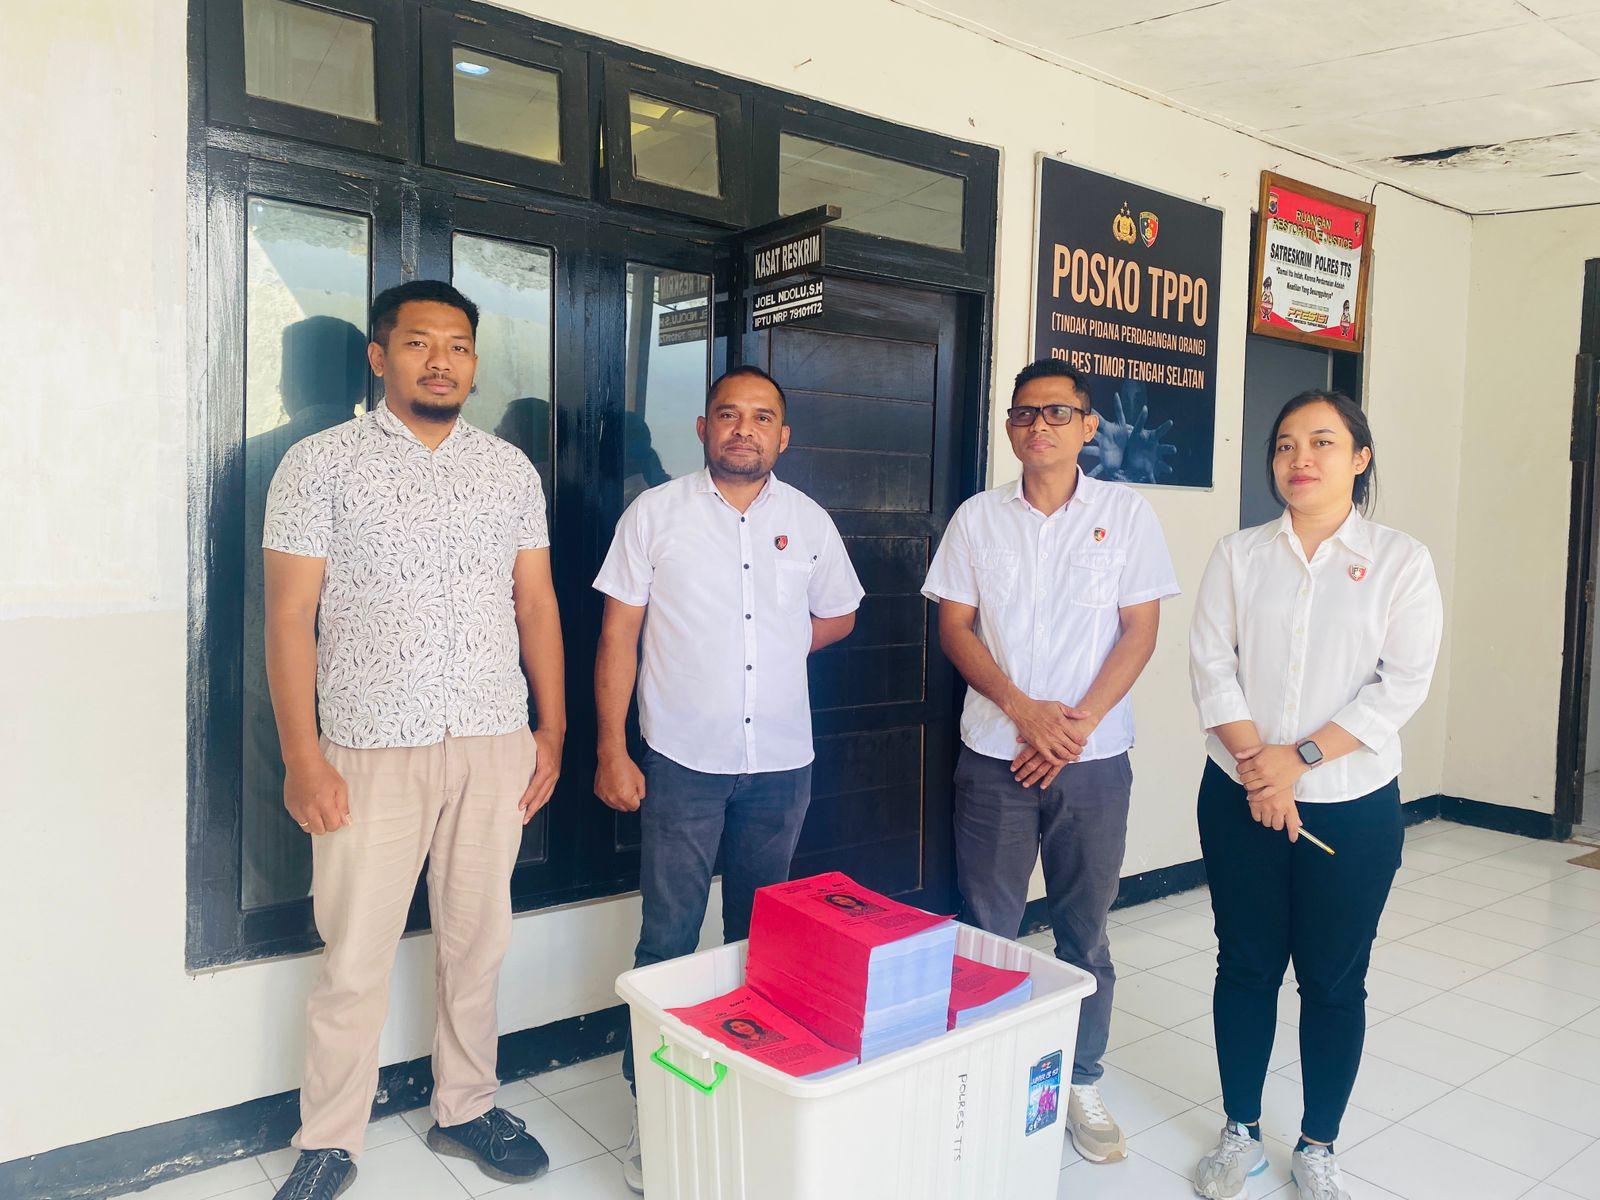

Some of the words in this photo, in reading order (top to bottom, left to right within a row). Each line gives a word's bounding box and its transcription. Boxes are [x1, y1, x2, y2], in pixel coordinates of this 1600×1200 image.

[1296, 210, 1332, 230] RUANGAN
[754, 247, 780, 279] KASAT
[782, 235, 820, 272] RESKRIM
[1270, 243, 1312, 268] SATRESKRIM
[1315, 255, 1339, 275] POLRES
[1340, 262, 1352, 278] TTS
[755, 294, 776, 309] JOEL
[1052, 243, 1140, 314] POSKO
[1148, 266, 1208, 328] TPPO
[754, 313, 771, 328] IPTU
[772, 310, 788, 324] NRP
[789, 302, 823, 320] 79101172
[1052, 312, 1088, 336] (TINDAK
[1089, 320, 1120, 340] PIDANA
[1121, 326, 1177, 349] PERDAGANGAN
[1178, 335, 1206, 357] ORANG)
[1093, 354, 1125, 377] TIMOR
[1128, 359, 1164, 384] TENGAH
[1166, 364, 1205, 390] SELATAN
[955, 1073, 968, 1130] POLRES
[953, 1136, 964, 1162] TTS
